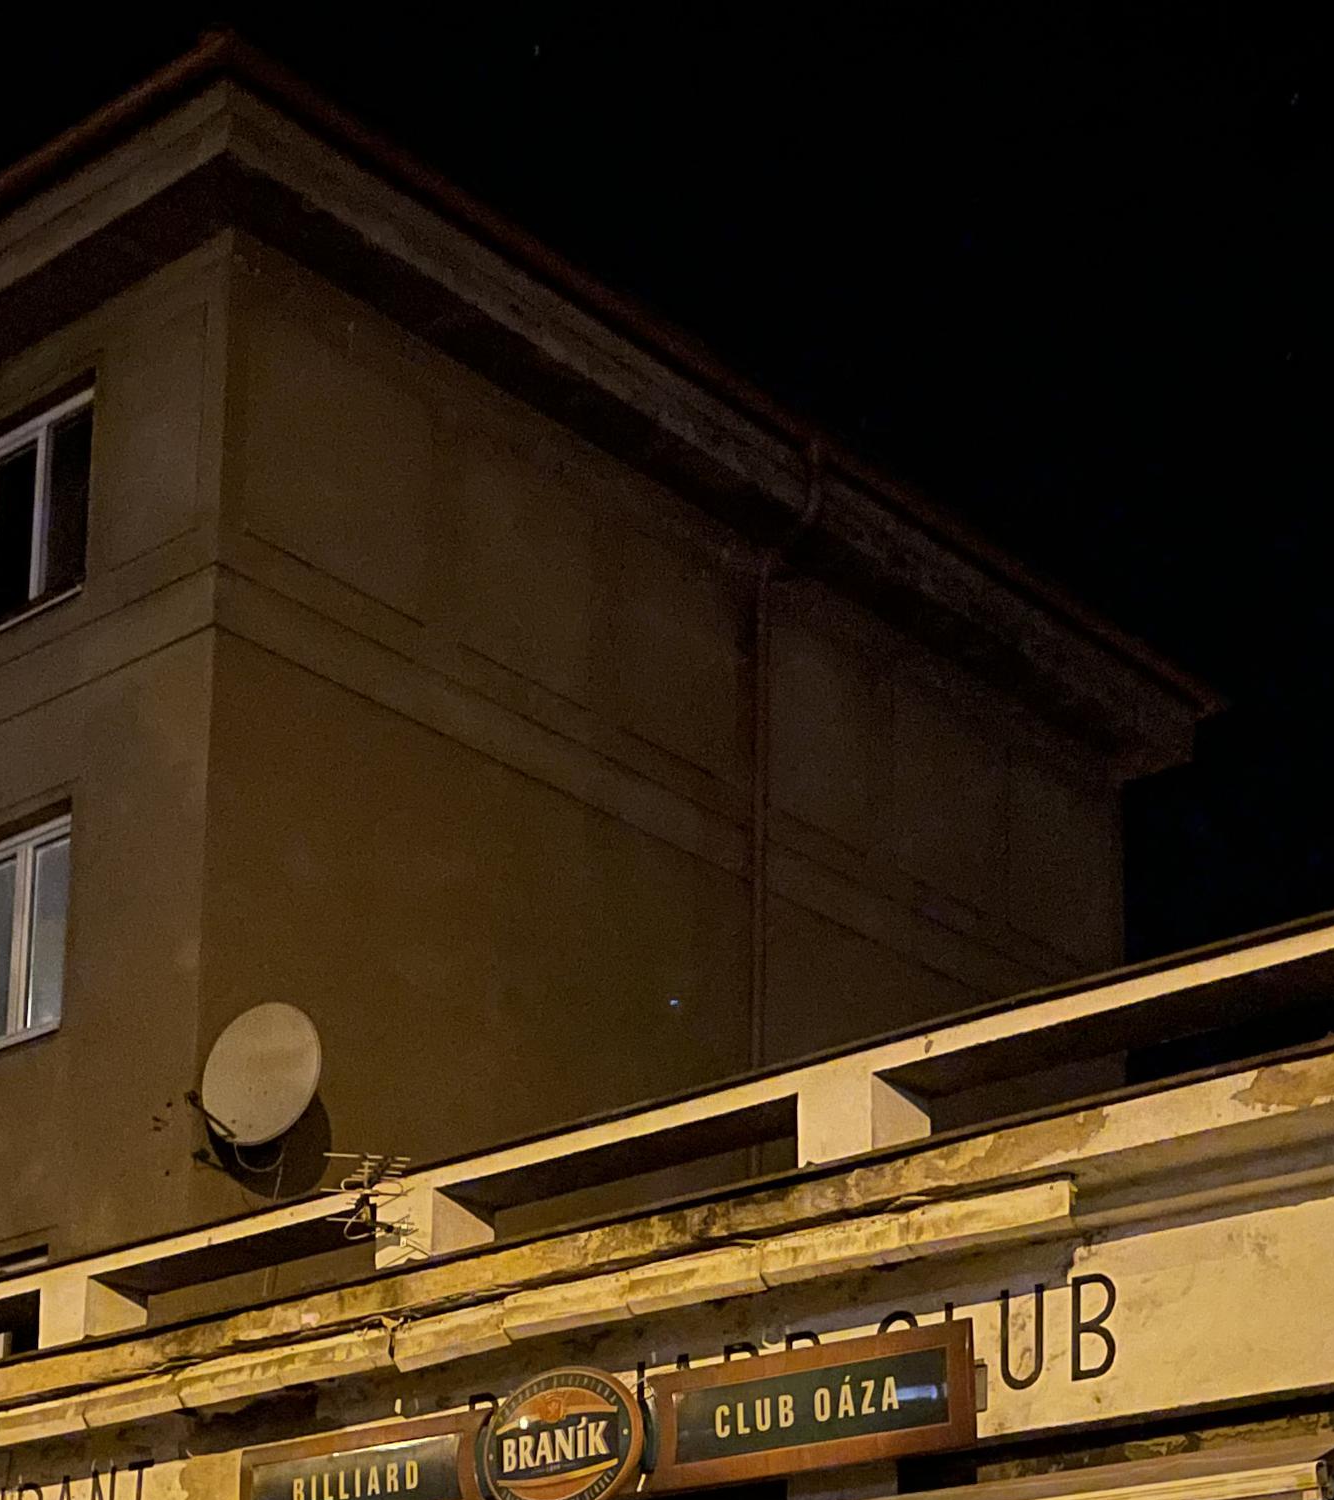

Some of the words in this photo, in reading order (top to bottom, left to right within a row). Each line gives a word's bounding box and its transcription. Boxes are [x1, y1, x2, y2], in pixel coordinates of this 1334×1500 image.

[877, 1272, 1116, 1390] UB
[715, 1394, 795, 1439] CLUB
[814, 1375, 899, 1422] OÁZA
[502, 1416, 610, 1473] BRANÍK
